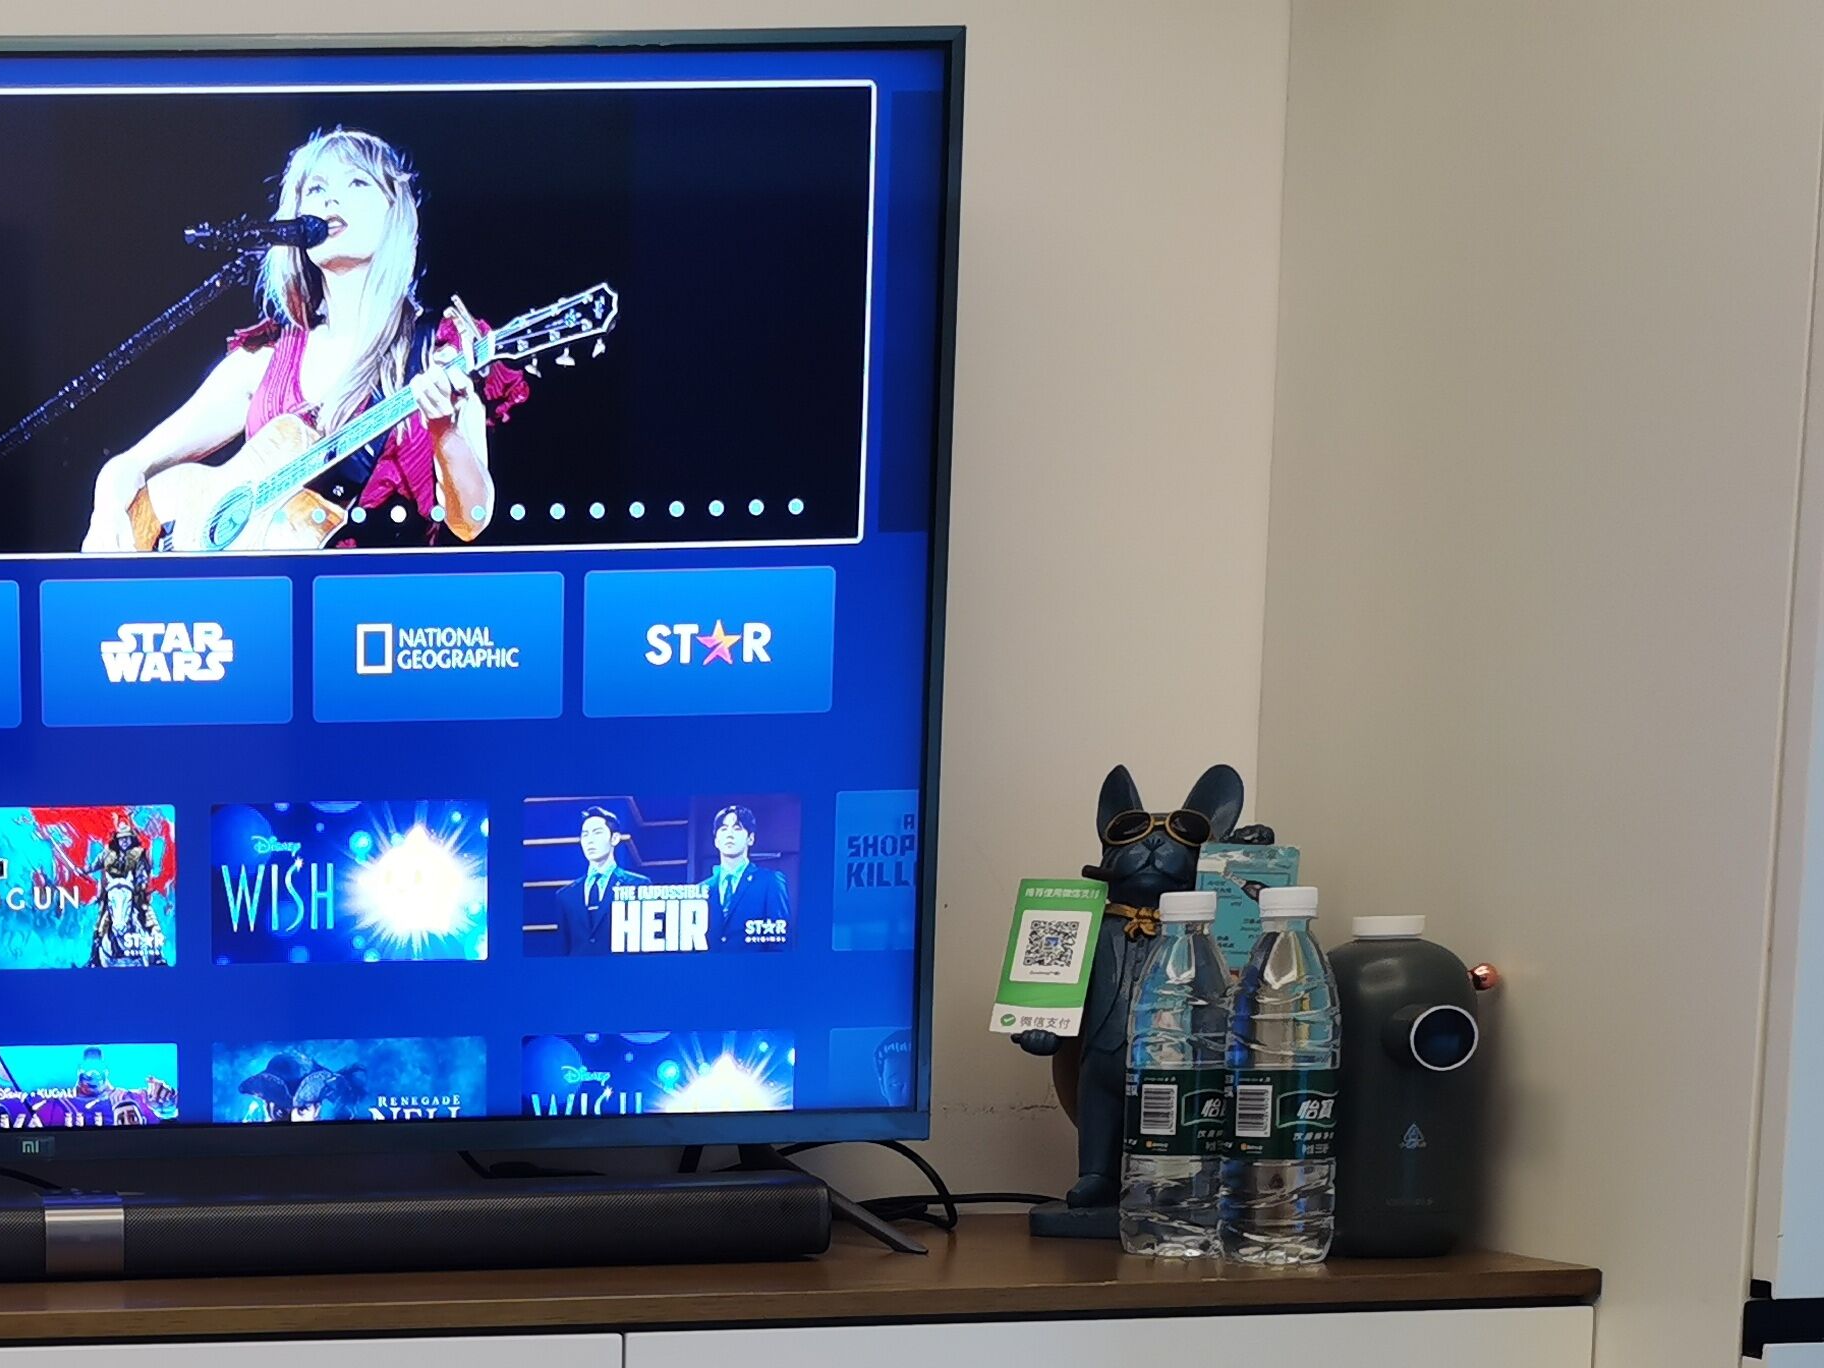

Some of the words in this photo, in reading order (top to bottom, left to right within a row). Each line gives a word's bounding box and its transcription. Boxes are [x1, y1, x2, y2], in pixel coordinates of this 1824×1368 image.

[101, 622, 234, 653] STAR
[397, 627, 494, 648] NATIONAL
[102, 651, 234, 683] WARS
[396, 646, 520, 670] GEOGRAPHIC
[846, 861, 918, 891] KILL
[221, 857, 335, 933] WISH
[612, 885, 636, 900] THE
[610, 899, 710, 953] HEIR
[1019, 1015, 1071, 1030] 微信支付
[377, 1094, 461, 1108] RENEGADE
[1200, 1098, 1226, 1119] 怡
